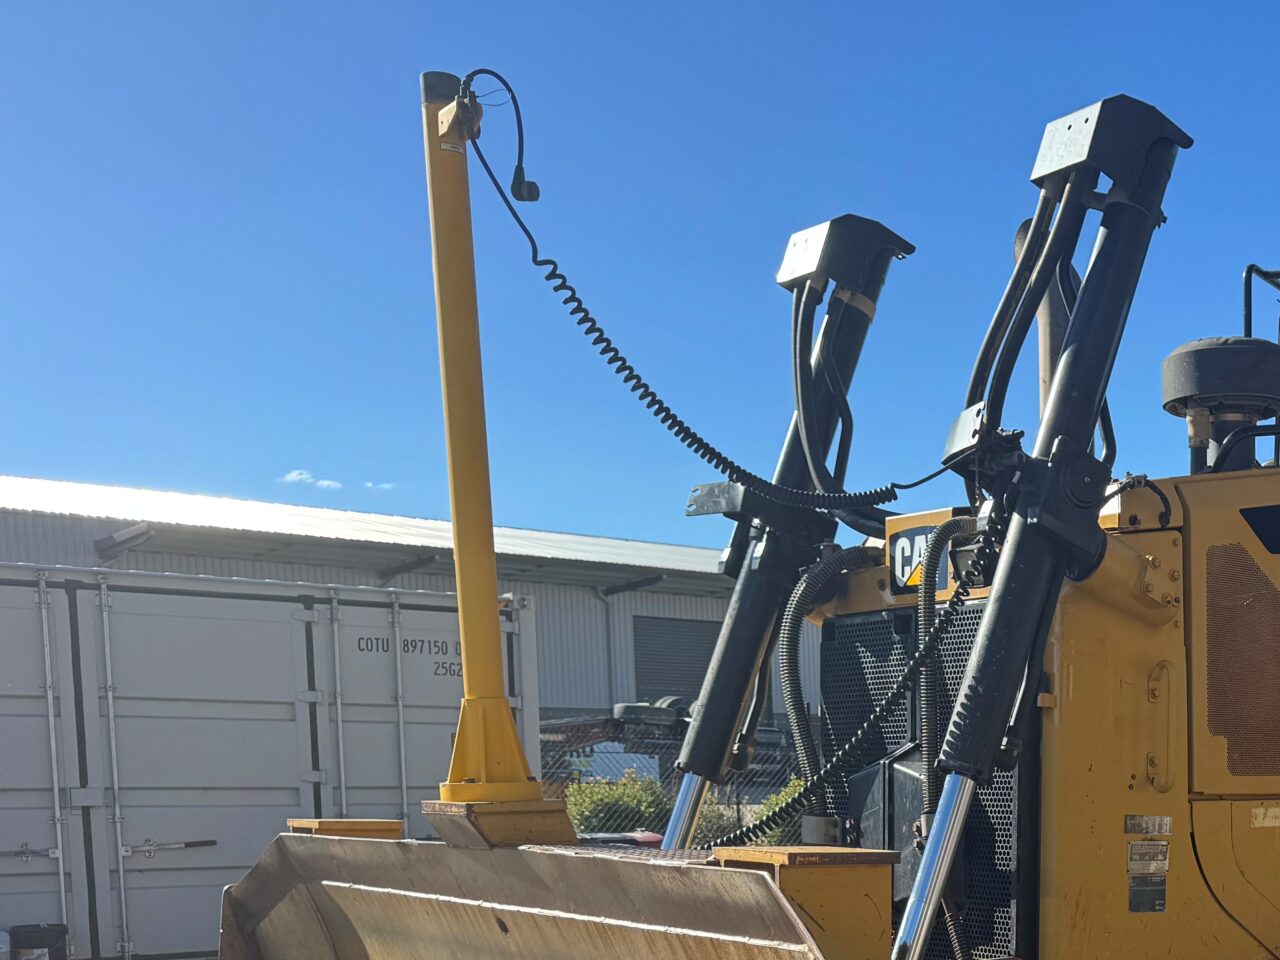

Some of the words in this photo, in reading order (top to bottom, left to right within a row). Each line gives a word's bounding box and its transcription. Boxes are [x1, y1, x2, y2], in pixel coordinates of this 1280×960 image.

[895, 534, 932, 587] CA
[358, 637, 389, 653] COTU
[402, 638, 448, 655] 897150
